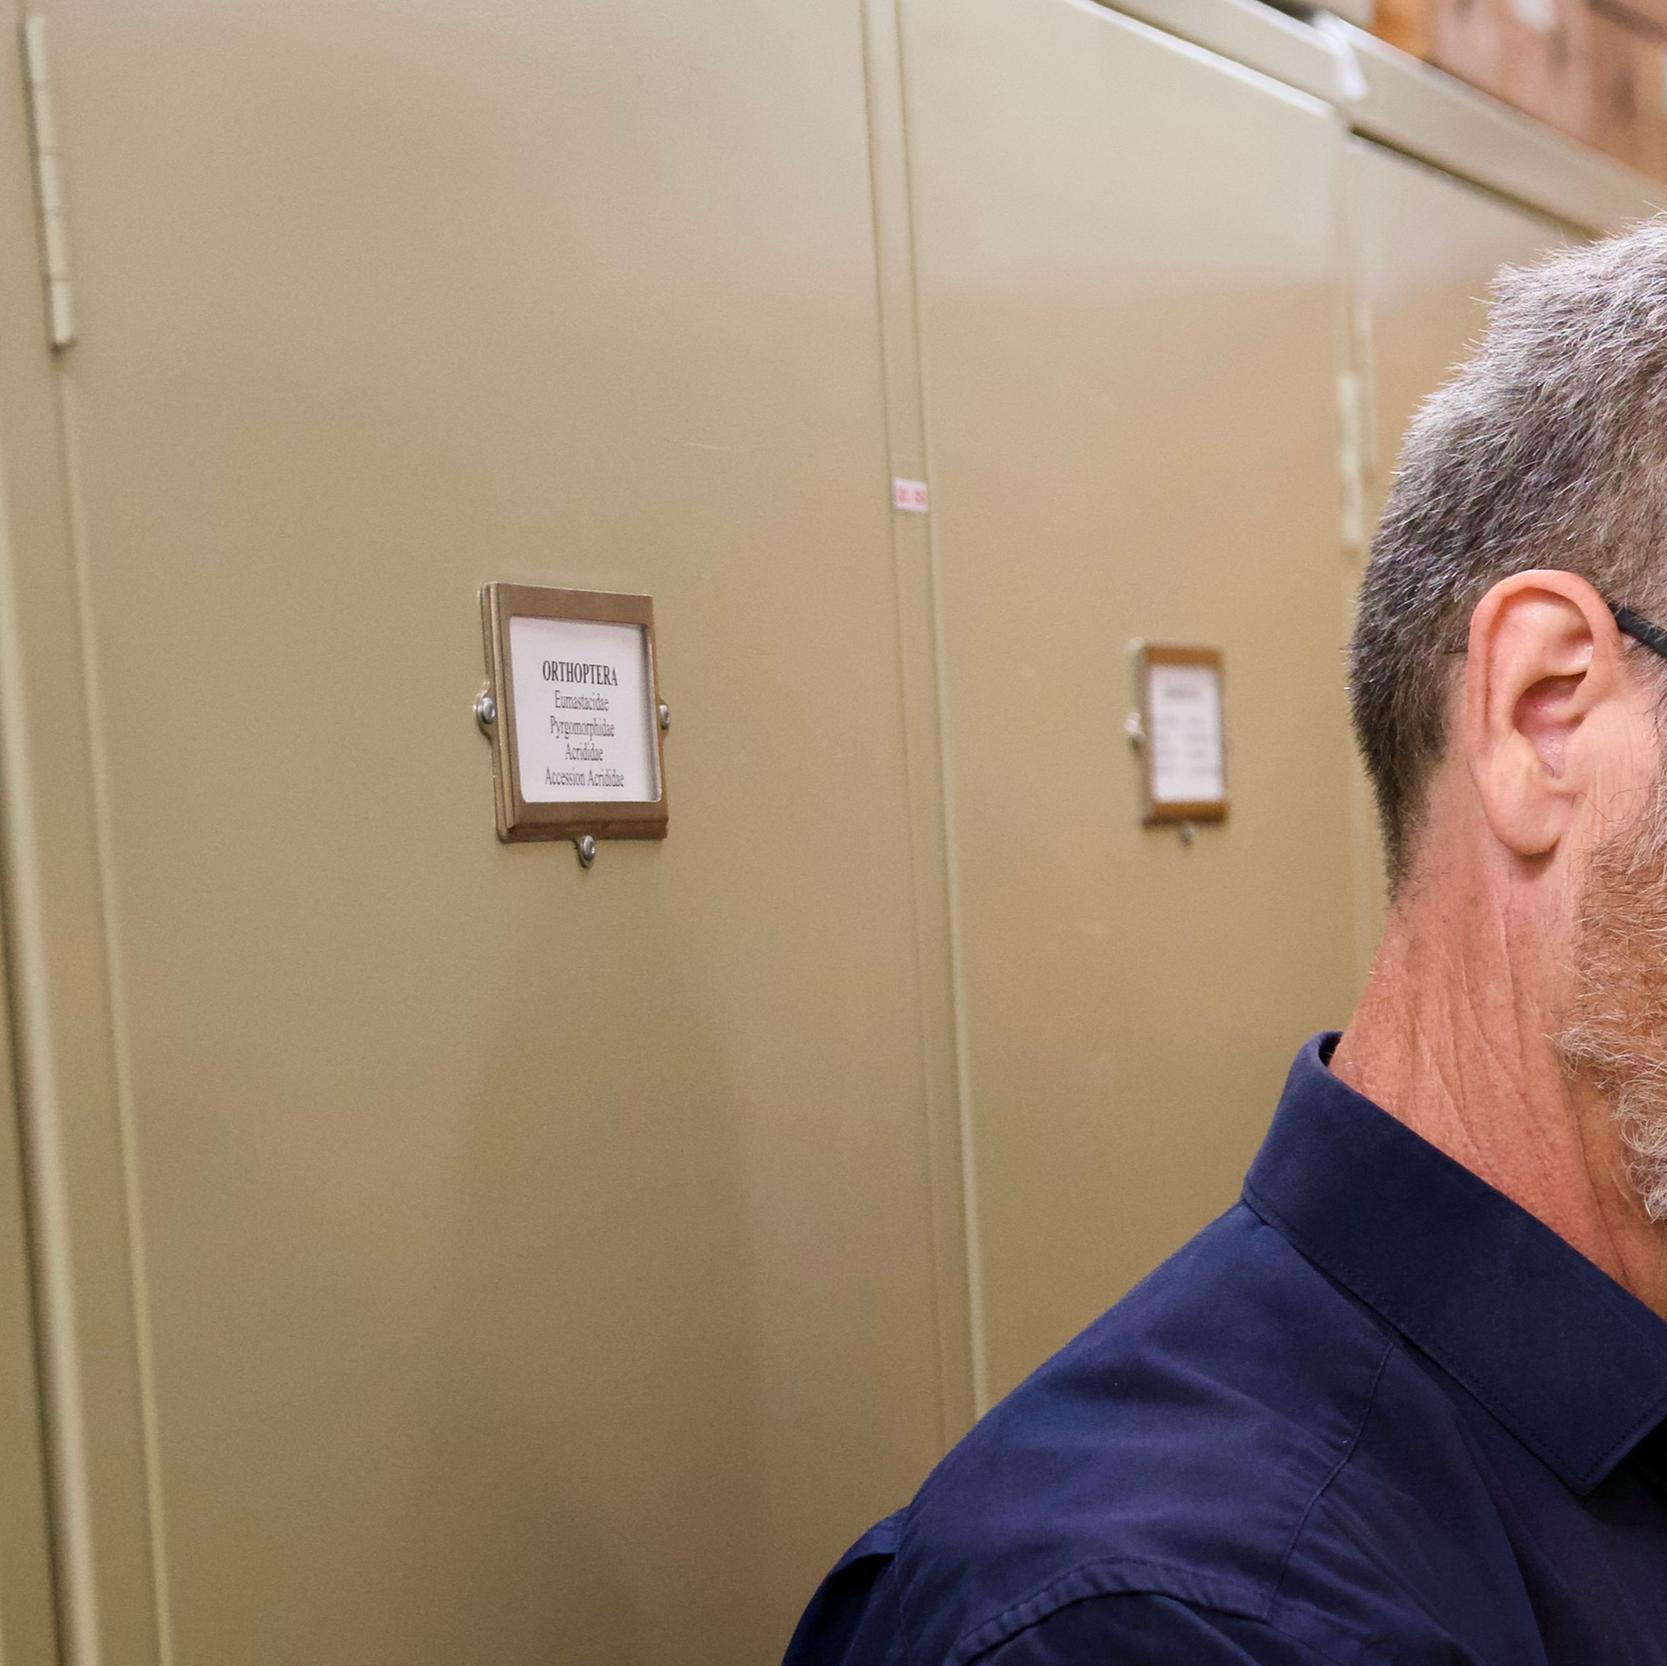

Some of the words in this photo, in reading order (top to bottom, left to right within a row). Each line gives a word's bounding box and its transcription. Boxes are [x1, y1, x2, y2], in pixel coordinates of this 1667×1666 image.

[542, 660, 618, 686] ORTHOPTERA
[554, 690, 609, 711] Eumastacidae
[550, 715, 615, 741] Pyrgomorphidae
[565, 742, 603, 761] Acrididae
[545, 766, 586, 786] Accession
[588, 768, 625, 787] Acrididae
